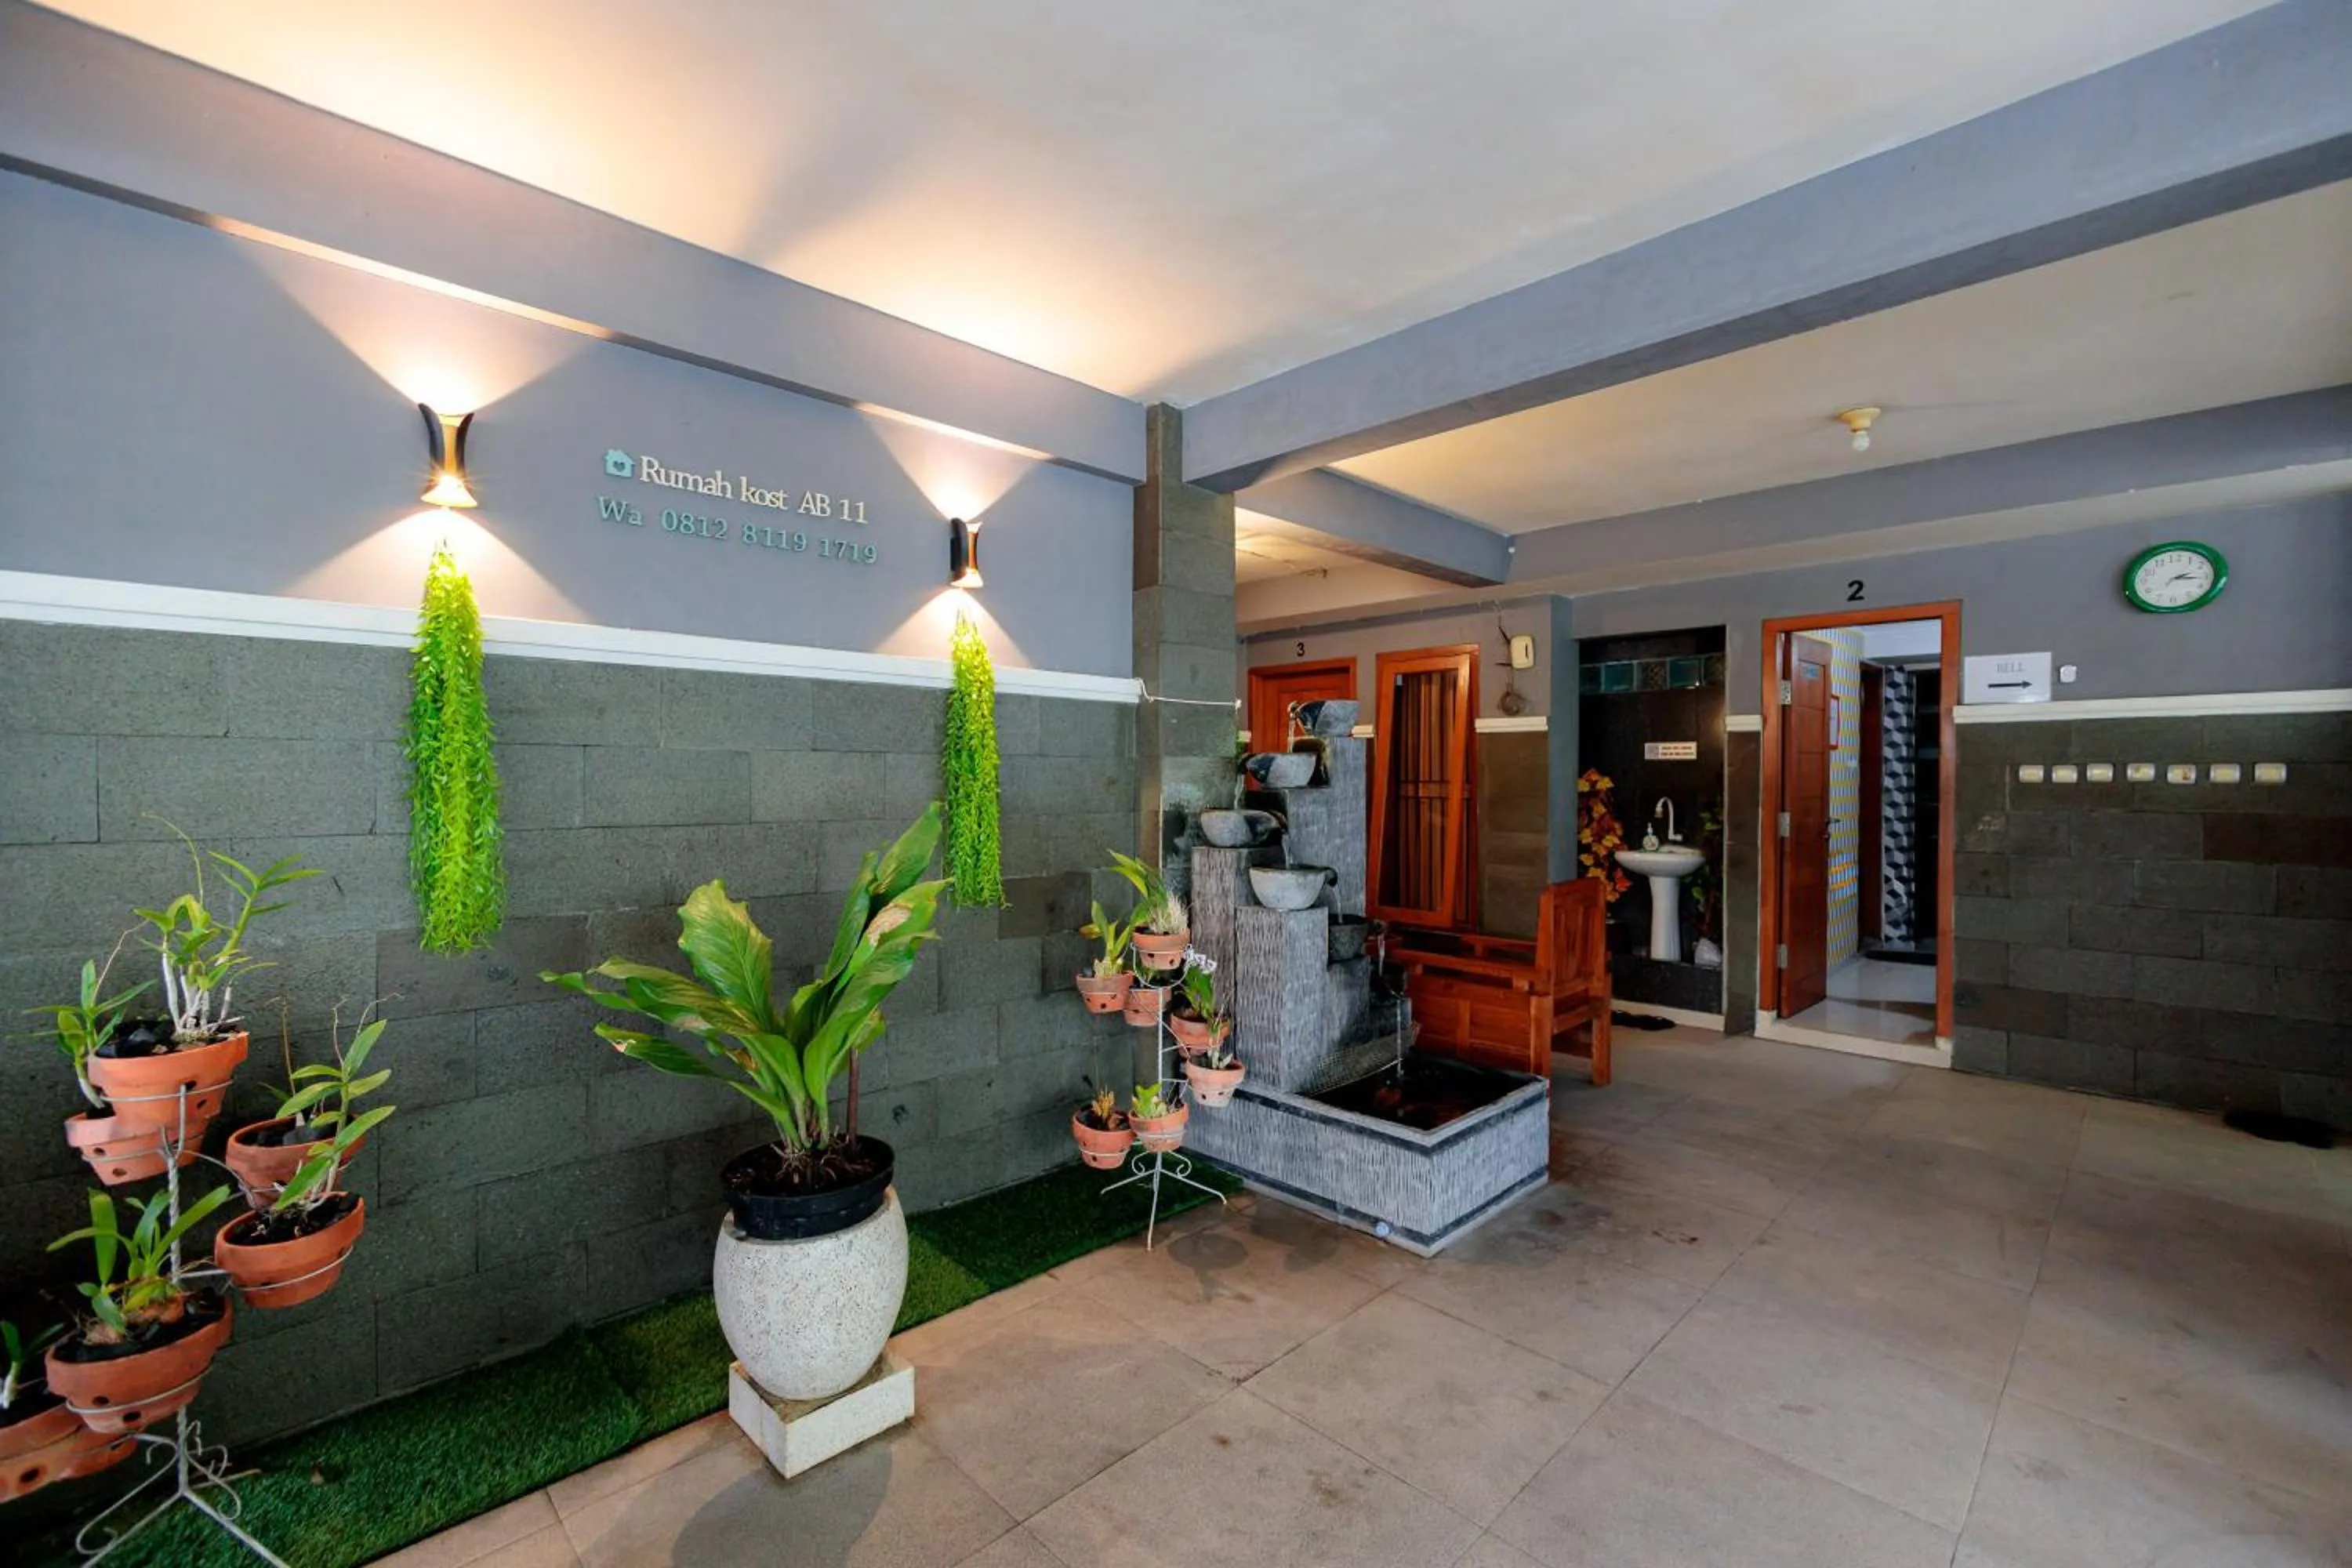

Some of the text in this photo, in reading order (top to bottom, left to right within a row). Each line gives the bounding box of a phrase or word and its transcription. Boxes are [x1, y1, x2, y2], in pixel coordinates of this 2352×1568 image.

[640, 455, 868, 524] Rumah kost AB 11
[597, 495, 878, 564] Wa 0812 8119 1719
[1847, 579, 1865, 602] 2
[1297, 642, 1305, 657] 3
